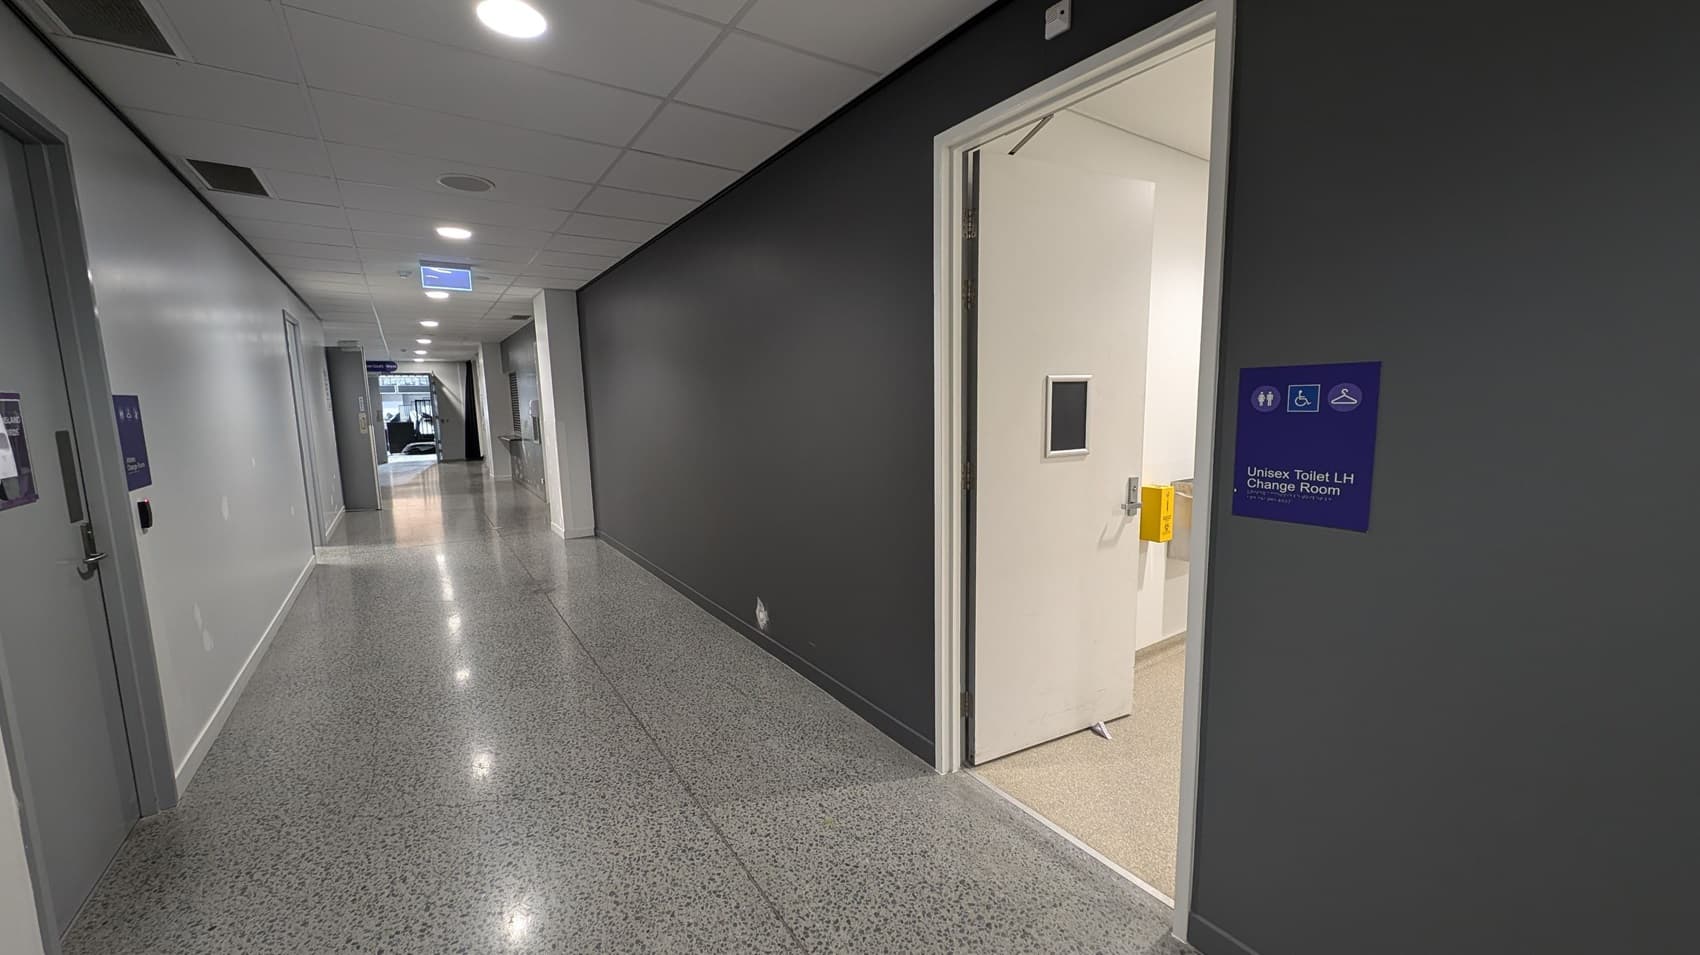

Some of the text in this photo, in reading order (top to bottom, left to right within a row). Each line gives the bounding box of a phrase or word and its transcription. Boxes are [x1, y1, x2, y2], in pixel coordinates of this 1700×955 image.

[1247, 466, 1355, 485] Unisex Toilet LH
[1247, 478, 1341, 496] Change Room
